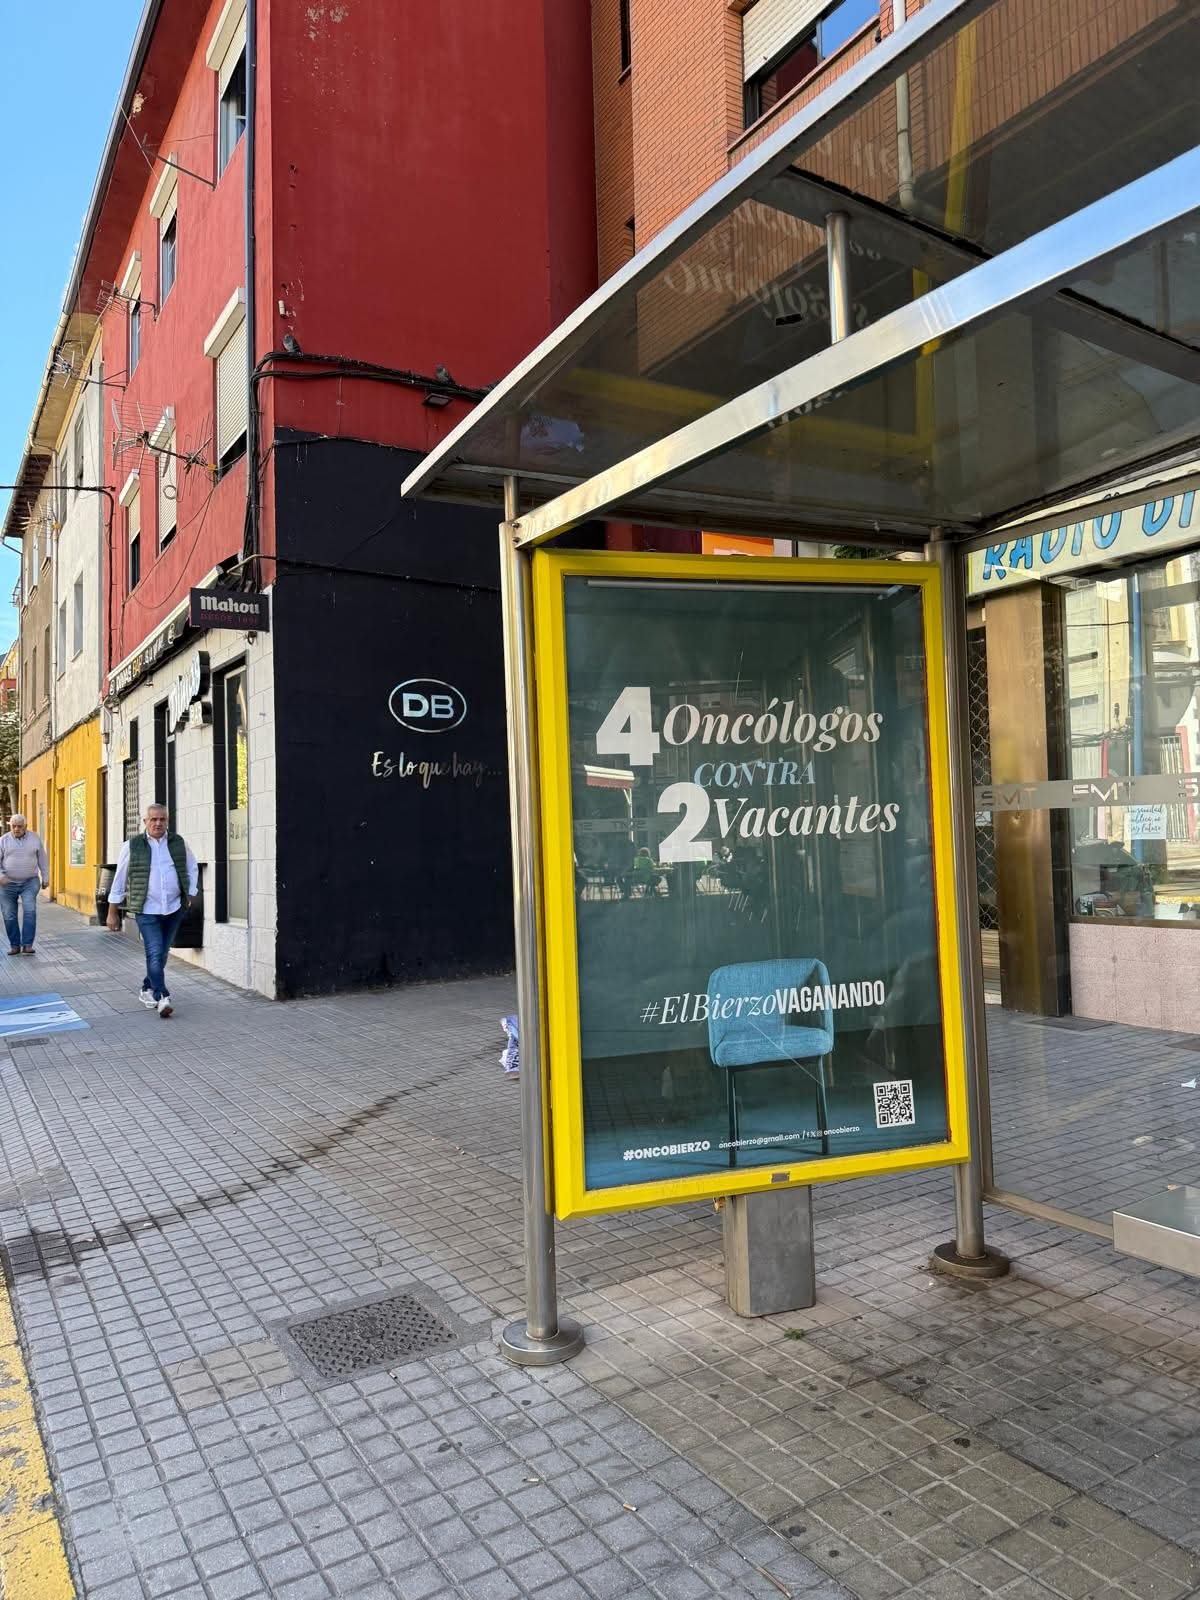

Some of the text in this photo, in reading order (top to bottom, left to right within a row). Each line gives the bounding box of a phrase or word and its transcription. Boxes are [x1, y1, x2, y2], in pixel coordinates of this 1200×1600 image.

[982, 496, 1122, 580] RADIO
[200, 595, 260, 614] Mahou
[402, 693, 454, 719] DB
[596, 687, 883, 766] 4 Oncólogos
[371, 751, 397, 777] Es
[399, 752, 417, 778] lo
[419, 759, 450, 789] que
[693, 759, 816, 789] CONTRA
[657, 782, 900, 863] 2 Vacantes
[640, 980, 885, 1025] #ElBierzoVAGANANDO
[623, 1141, 710, 1160] #ONCOBIERZO
[718, 1132, 800, 1149] oncobierzo@gmail.com
[823, 1126, 860, 1135] oncobierzo
